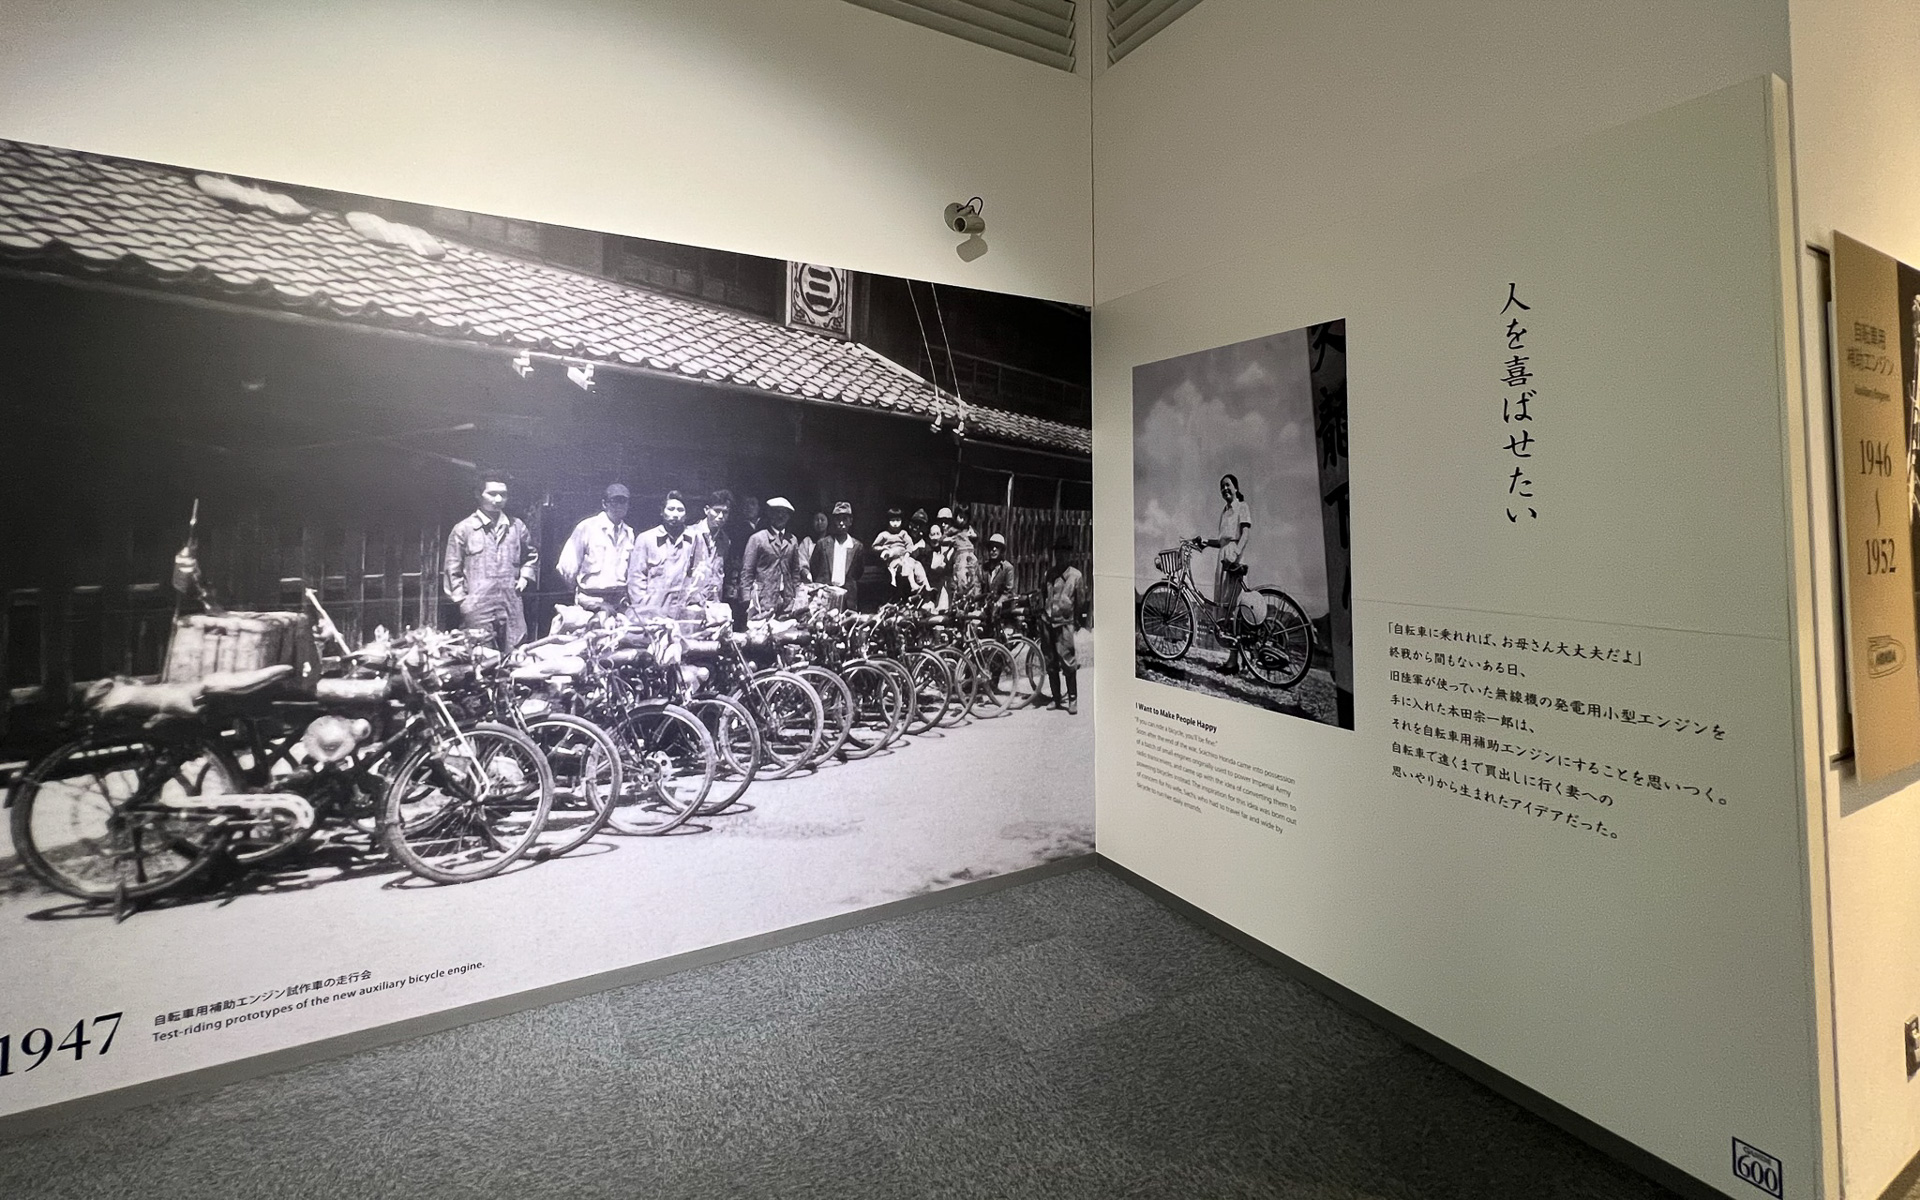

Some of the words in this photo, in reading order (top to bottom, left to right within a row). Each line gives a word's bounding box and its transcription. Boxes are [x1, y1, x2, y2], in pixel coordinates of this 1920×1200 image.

[1500, 282, 1537, 523] 人を喜ばせたい
[1860, 439, 1892, 477] 1946
[1866, 538, 1896, 575] 1952
[1388, 622, 1643, 667] 「自転車に乗れれば、お母さん大丈夫だよ」
[1388, 645, 1526, 678] 終戦から間もないある日、
[1138, 702, 1152, 714] Want
[1160, 708, 1175, 720] Make
[1176, 713, 1196, 726] People
[1196, 719, 1218, 734] Happy
[1390, 669, 1726, 742] 旧陸軍が使っていた無線機の発電用小型エンジンを
[1390, 693, 1535, 734] 手に入れた本田宗一郎は、
[1391, 717, 1727, 806] それを自転車用補助エンジンにすることを思いつく。
[1391, 741, 1614, 807] 自転車で遠くまで買出しに行く妻への
[1391, 765, 1618, 840] 思いやりから生まれたアイデアだった。
[152, 1019, 222, 1042] Test-riding
[225, 1003, 293, 1028] prototypes
[296, 998, 308, 1010] of
[310, 994, 330, 1007] the
[332, 990, 357, 1002] new
[359, 978, 406, 996] auxiliary
[408, 968, 446, 985] bicycle
[447, 960, 486, 976] engine.
[154, 969, 372, 1026] 自転車用補助エンジン試作車の走行会
[0, 1011, 123, 1077] 1947
[1737, 1154, 1778, 1192] 600
